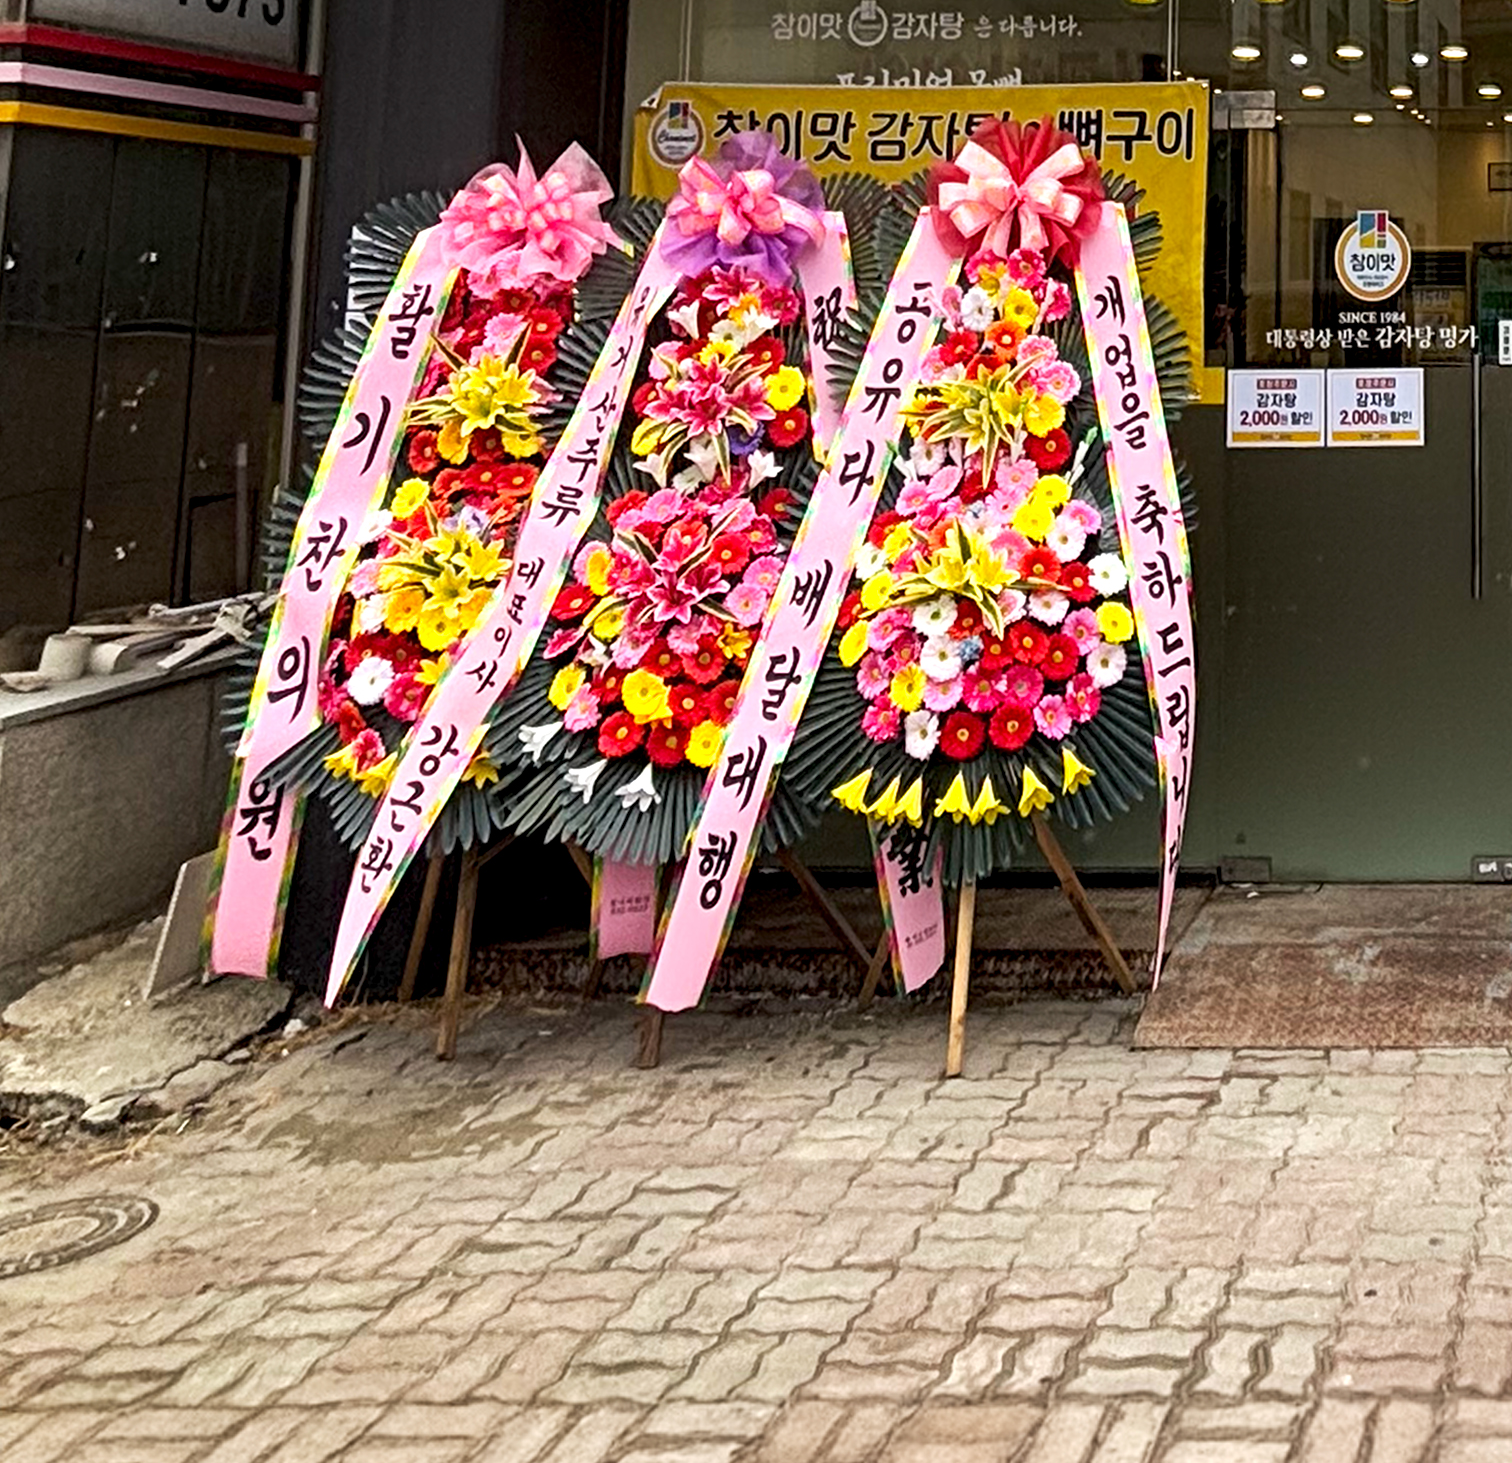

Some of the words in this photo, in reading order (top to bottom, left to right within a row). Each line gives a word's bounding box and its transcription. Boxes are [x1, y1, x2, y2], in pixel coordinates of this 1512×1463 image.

[771, 12, 843, 42] 참이맛
[891, 11, 965, 41] 감자탕
[1349, 252, 1396, 273] 참이맛
[1338, 311, 1377, 325] SINCE
[1379, 311, 1406, 325] 1984
[1265, 327, 1334, 349] 대통령상
[1337, 328, 1371, 349] 받은
[1375, 325, 1436, 350] 감자탕
[1439, 325, 1480, 350] 명가
[1093, 275, 1150, 451] 개업을
[1256, 392, 1297, 409] 감자탕
[1356, 391, 1396, 408] 감자탕
[1291, 411, 1313, 426] 할인
[1390, 410, 1413, 425] 할인
[236, 282, 435, 862] 활기찬의원
[466, 556, 545, 694] 대표이사
[697, 559, 833, 910] 배달대행
[360, 723, 460, 894] 강근환
